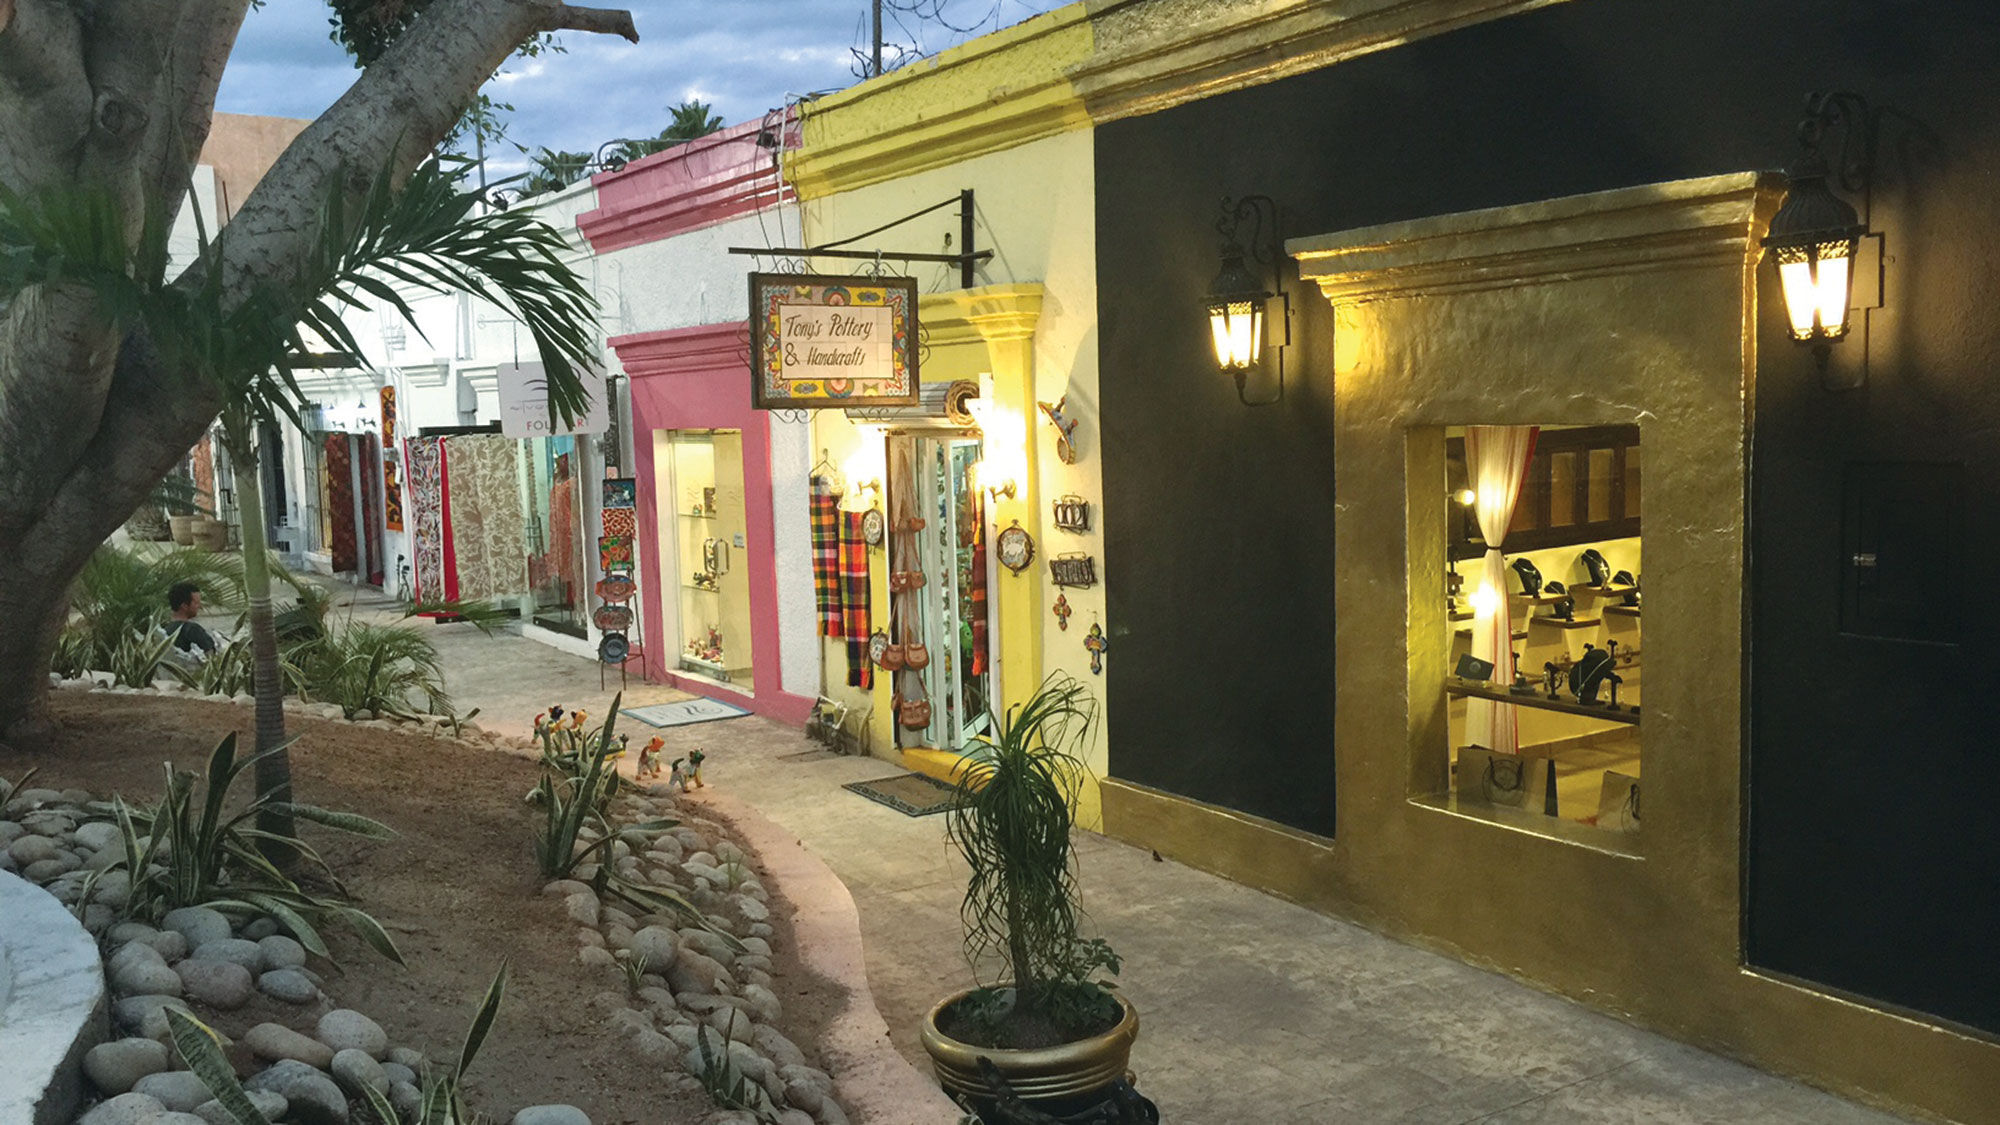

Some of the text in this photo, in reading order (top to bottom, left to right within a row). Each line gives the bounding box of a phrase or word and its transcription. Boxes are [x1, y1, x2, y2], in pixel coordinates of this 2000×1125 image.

[785, 313, 873, 341] Tony's Pottery
[784, 342, 800, 366] &
[526, 420, 553, 431] FOL
